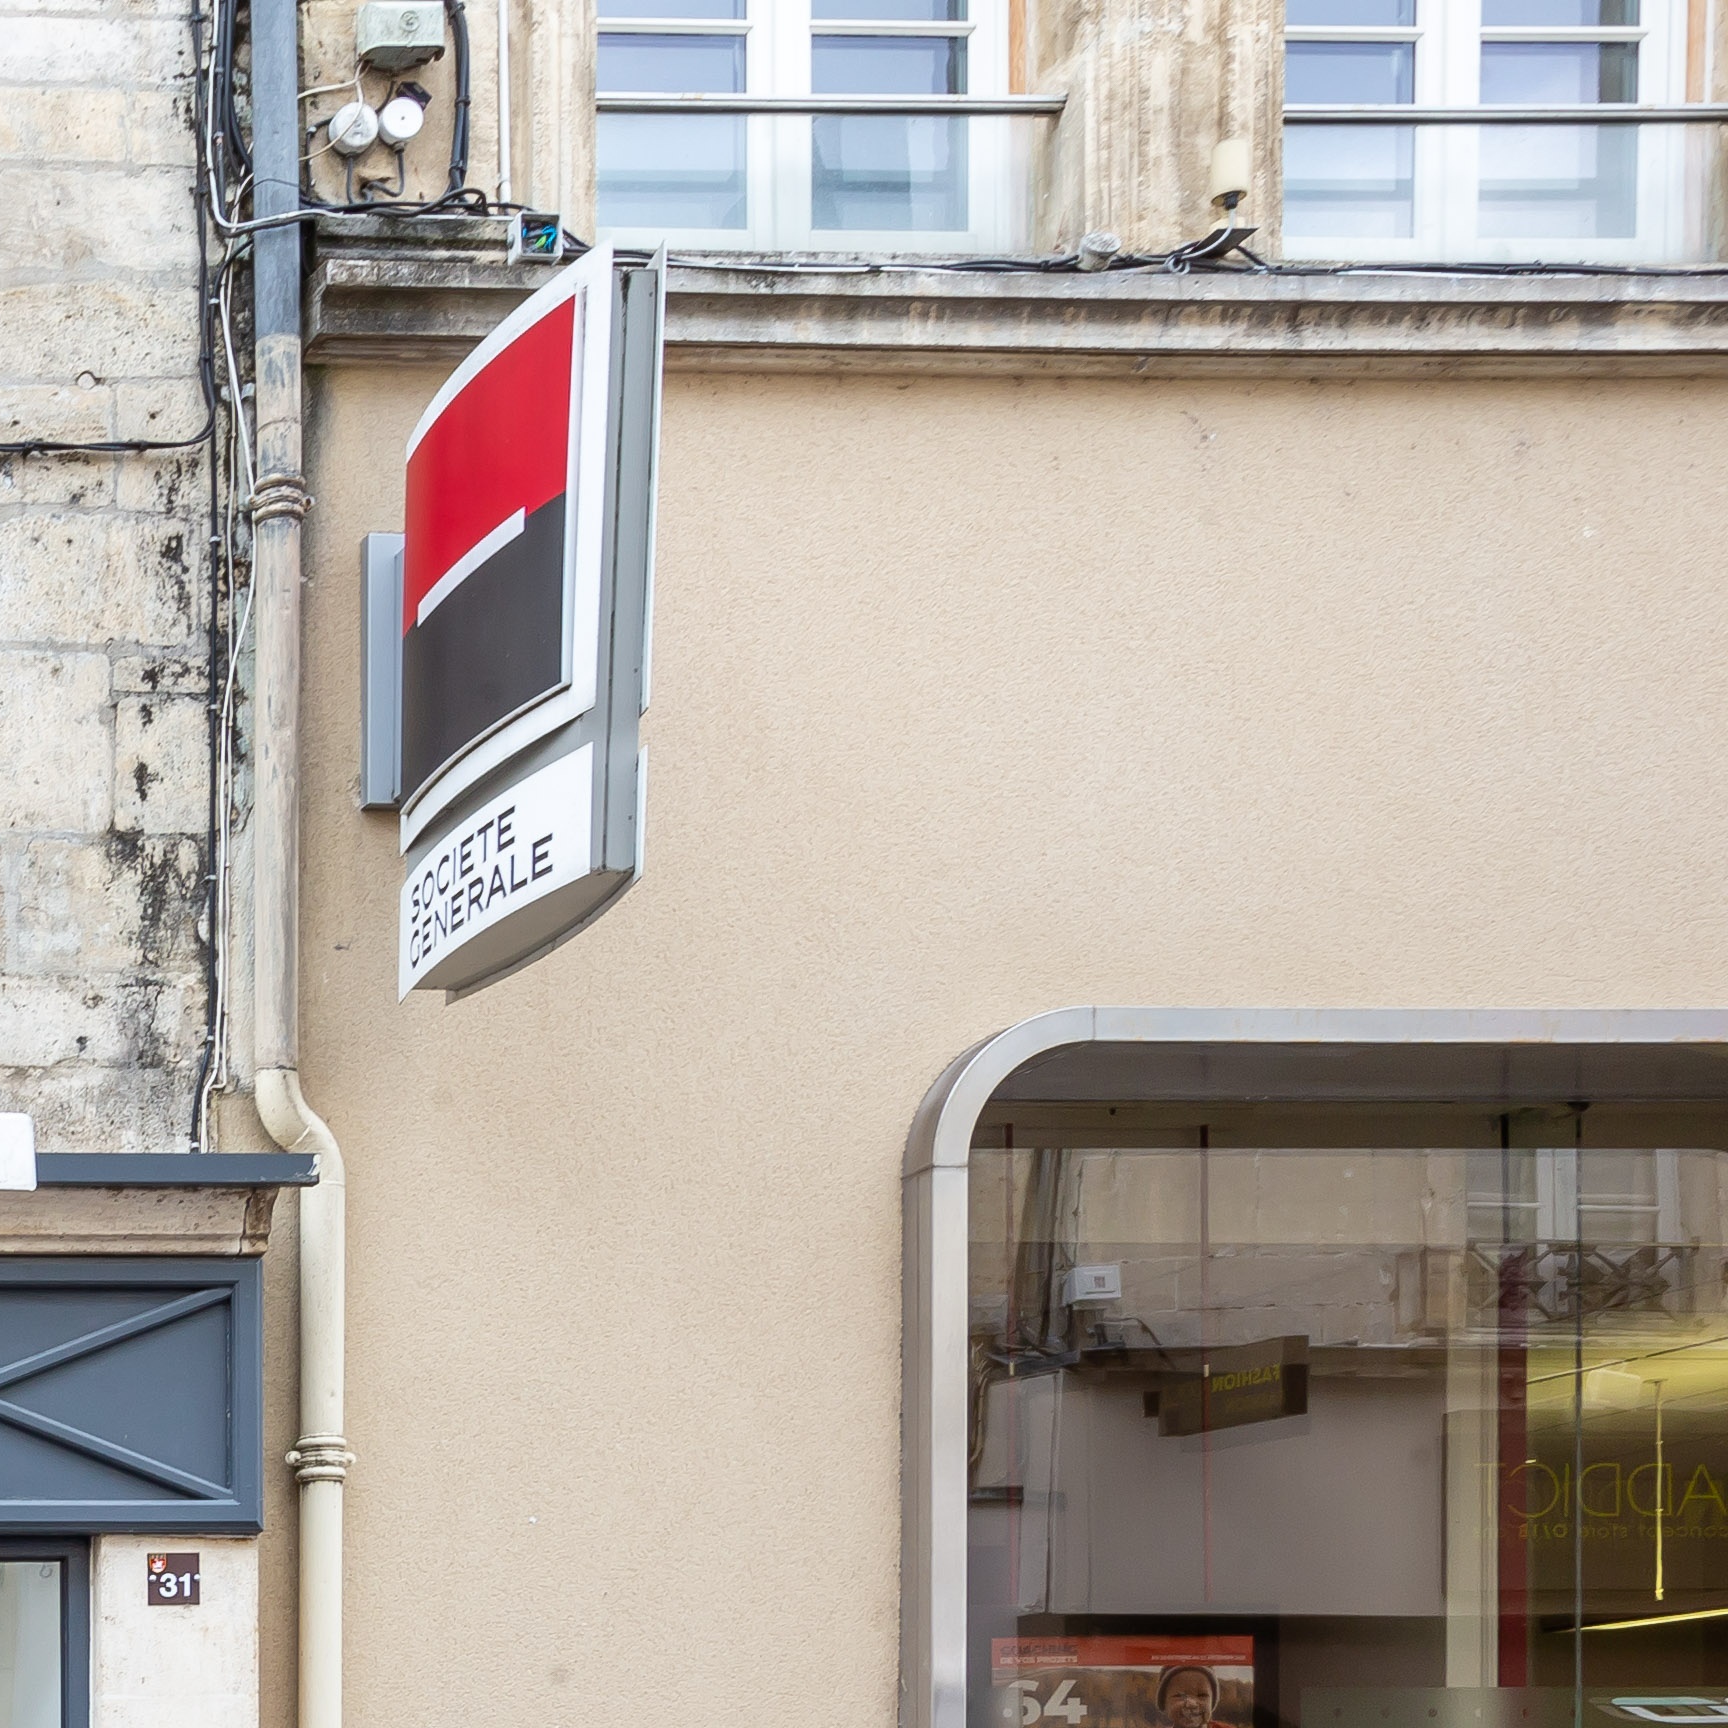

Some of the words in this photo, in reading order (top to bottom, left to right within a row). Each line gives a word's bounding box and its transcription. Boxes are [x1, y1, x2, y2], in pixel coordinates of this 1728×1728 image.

[410, 833, 553, 969] GENERALE
[411, 805, 516, 924] SOCIETE
[159, 1572, 191, 1598] 31
